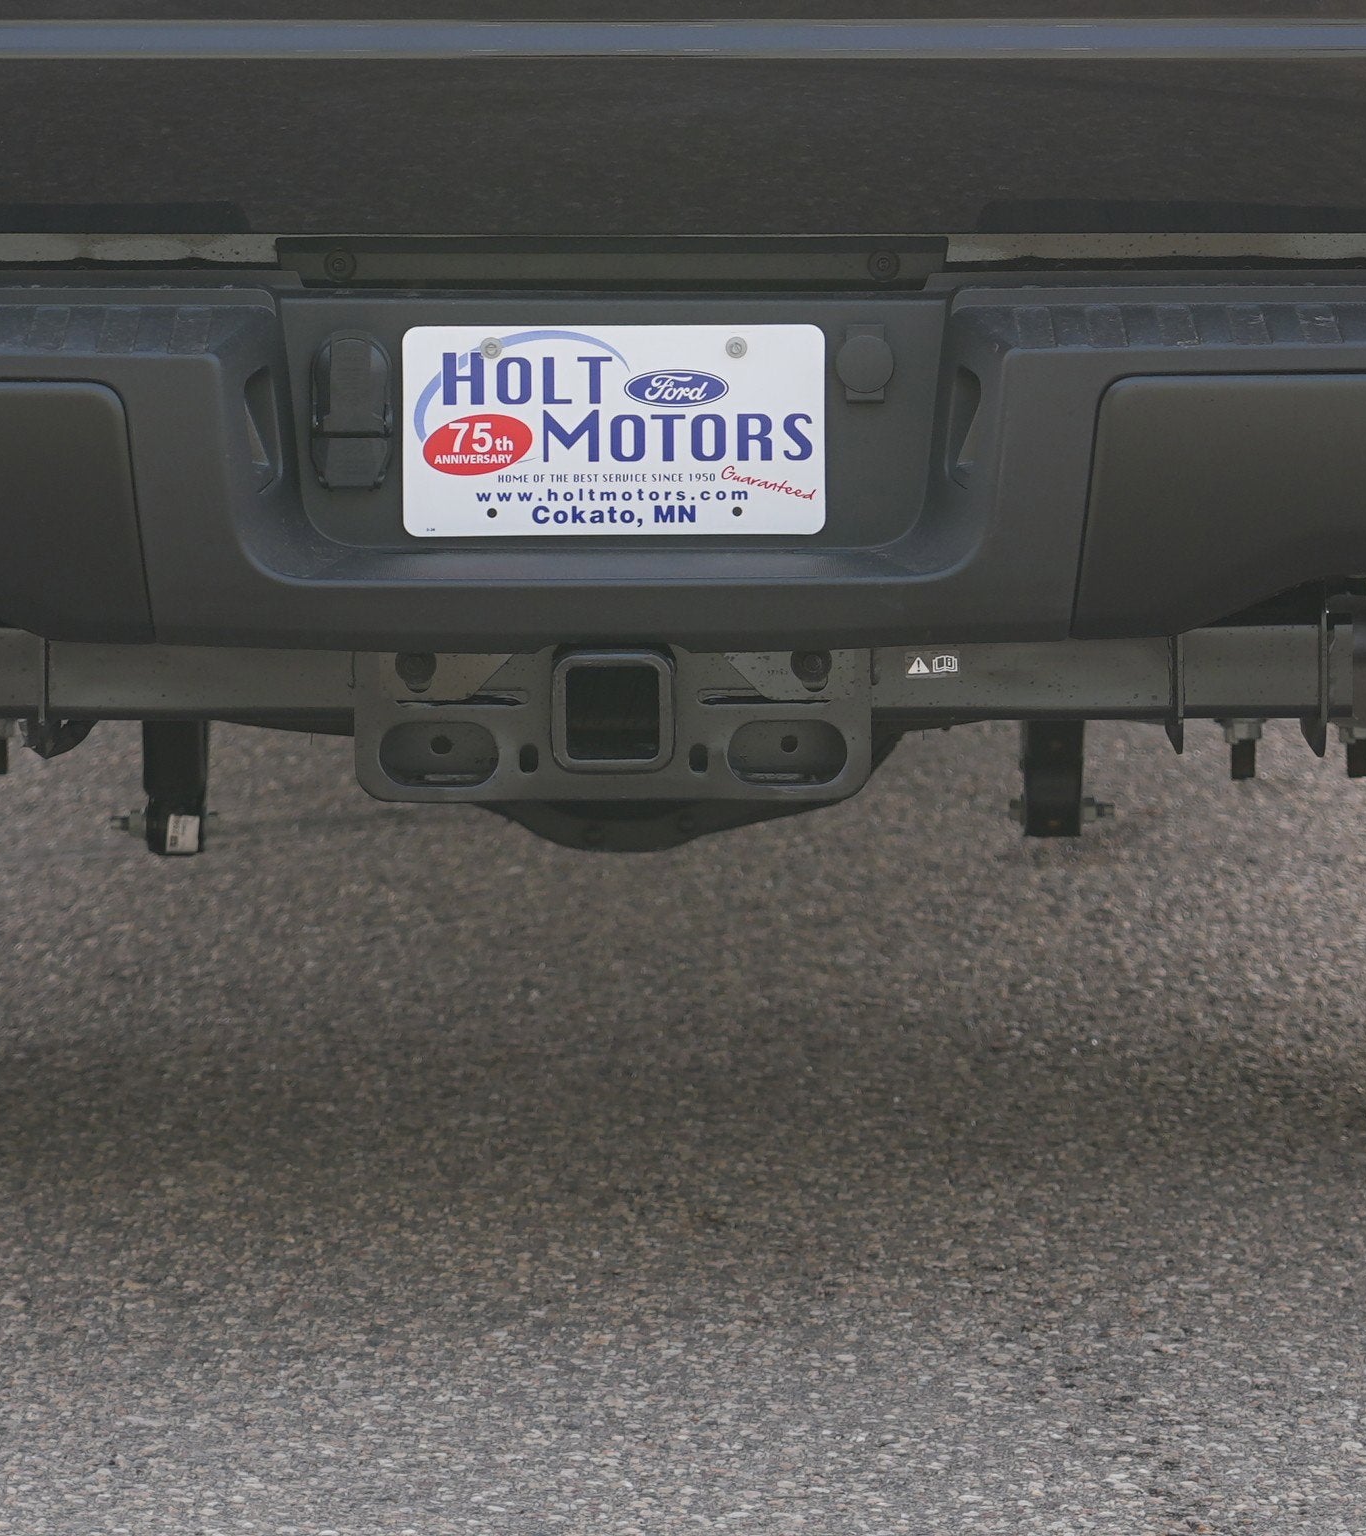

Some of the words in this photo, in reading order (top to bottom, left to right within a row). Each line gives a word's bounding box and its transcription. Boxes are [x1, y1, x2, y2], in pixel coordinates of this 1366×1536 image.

[442, 351, 613, 406] HOLT
[644, 374, 709, 402] Ford
[447, 421, 514, 453] 75th
[542, 409, 814, 463] MOTORS
[434, 453, 513, 465] ANNIVERSARY
[475, 488, 750, 502] www.holtmotors.com
[497, 474, 529, 483] HOME
[533, 474, 546, 483] OF
[550, 474, 569, 483] THE
[573, 473, 599, 483] BEST
[602, 473, 648, 483] SERVICE
[651, 472, 684, 482] SINCE
[688, 472, 716, 482] 1950
[720, 464, 819, 502] Guaranteed
[531, 504, 644, 528] Cokato,
[653, 504, 697, 524] MN
